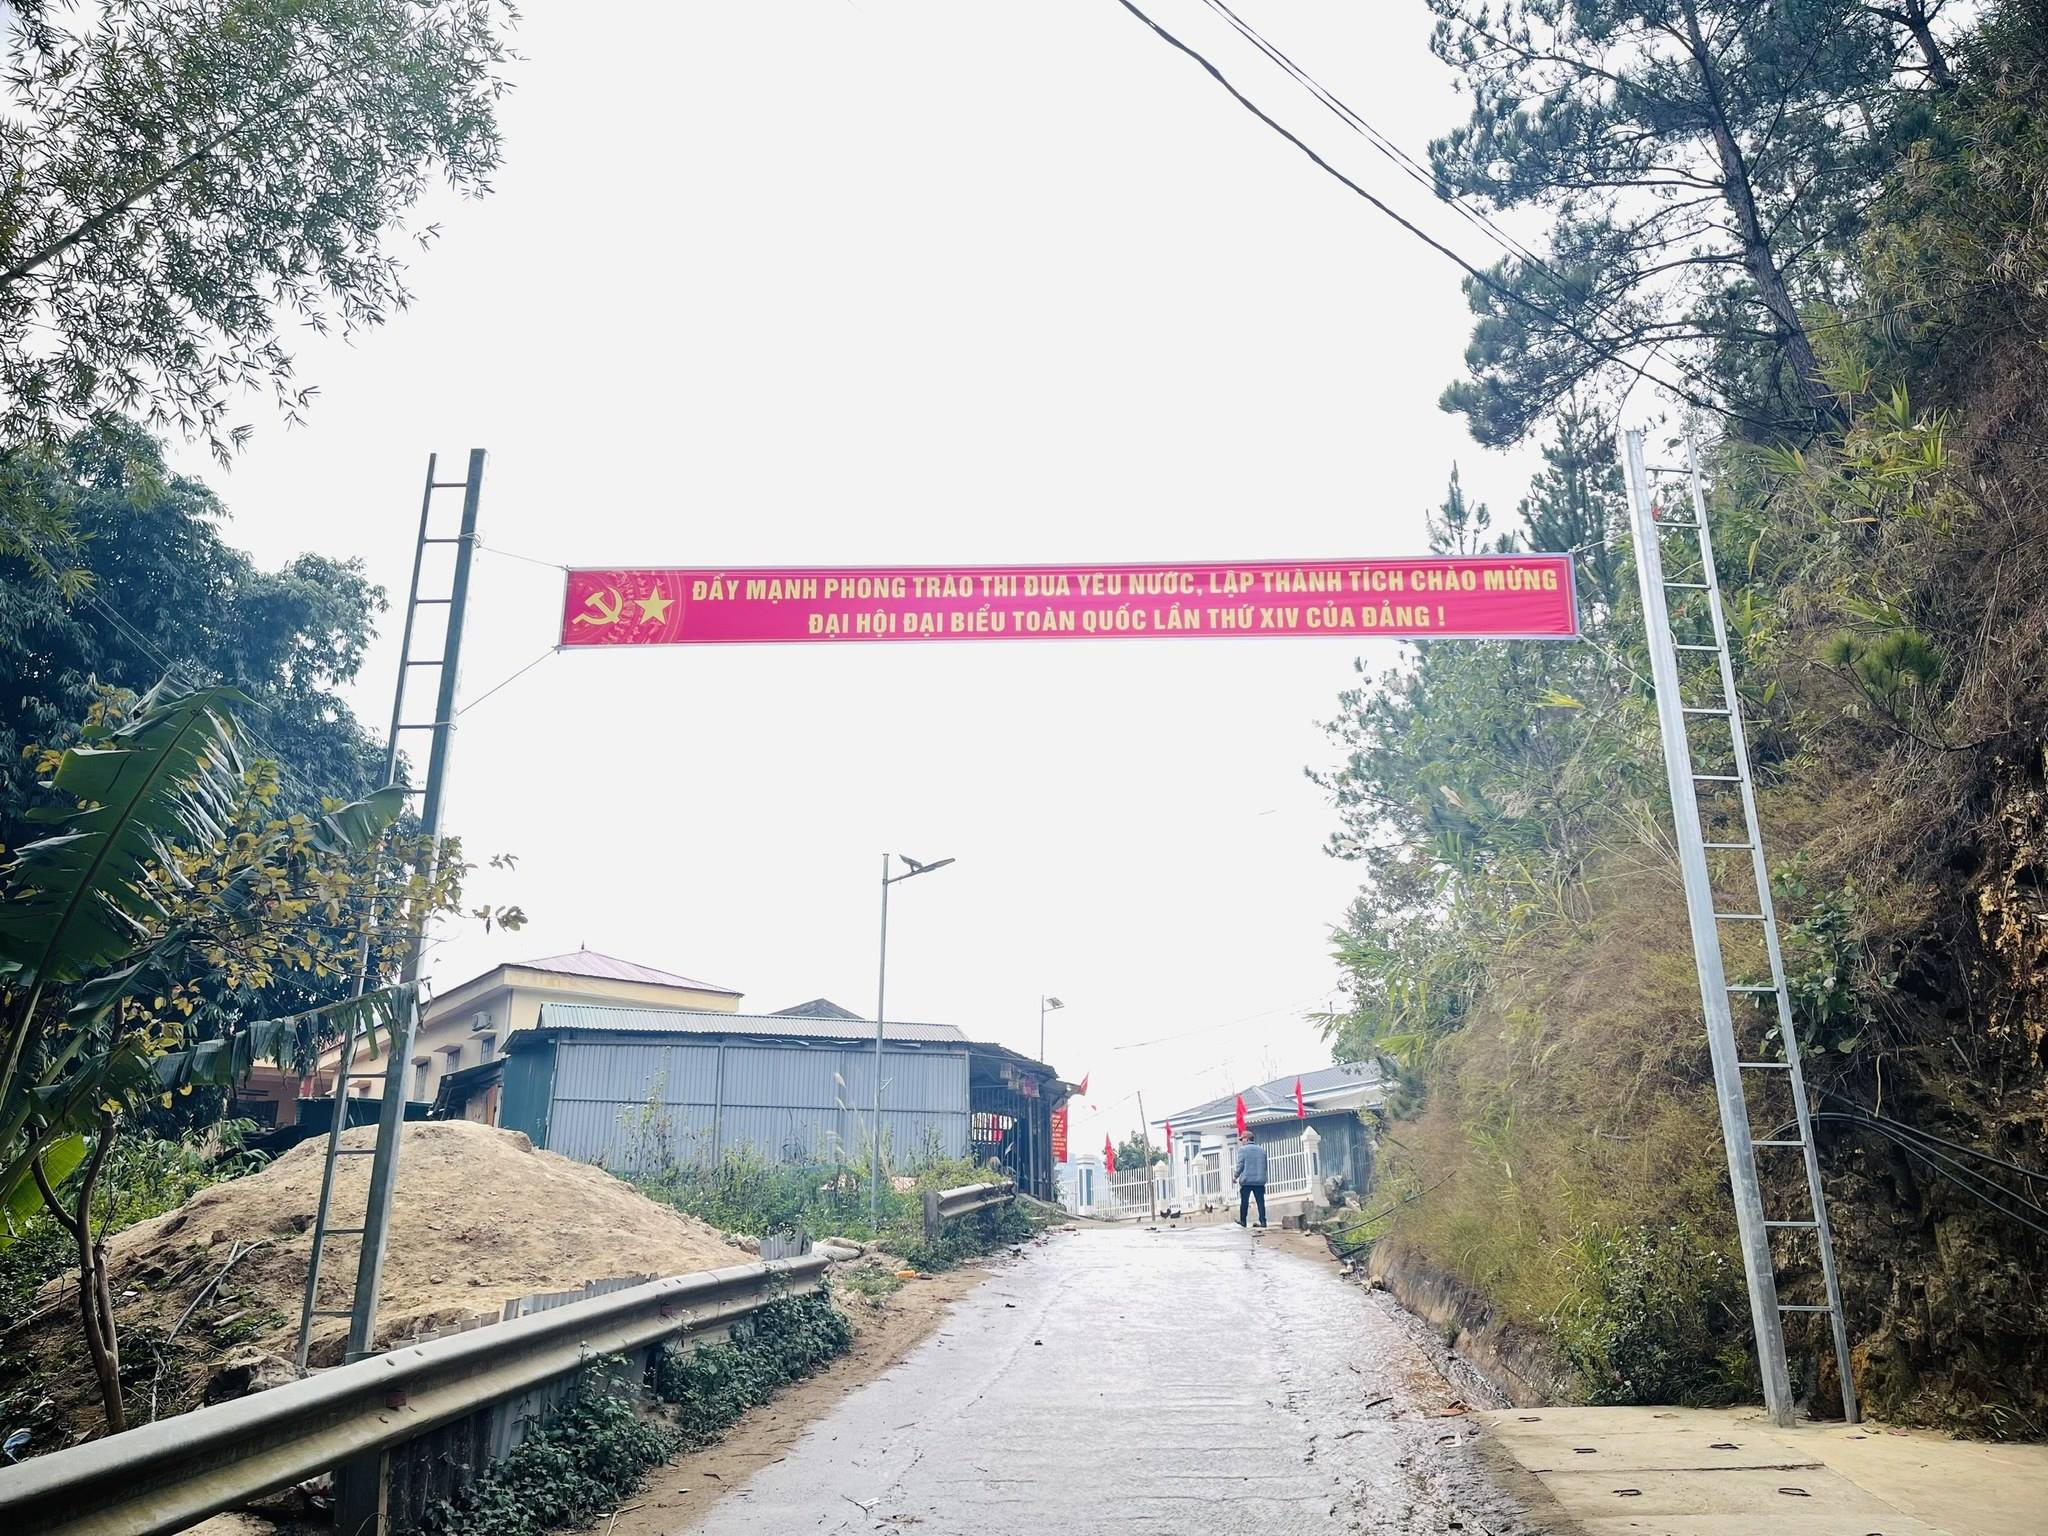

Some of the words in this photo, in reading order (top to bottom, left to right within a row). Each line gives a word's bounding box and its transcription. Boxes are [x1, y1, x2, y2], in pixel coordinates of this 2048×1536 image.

[746, 578, 817, 604] MẠNH
[824, 577, 905, 599] PHONG
[980, 575, 1017, 597] THI
[1023, 574, 1070, 596] ĐUA
[1076, 571, 1121, 596] YÊU
[1129, 571, 1203, 598] NƯỚC,
[1209, 570, 1255, 599] LẬP
[1262, 568, 1342, 593] THÀNH
[1348, 567, 1404, 592] TÍCH
[1411, 565, 1476, 592] CHÀO
[1484, 565, 1558, 591] MỪNG
[808, 612, 849, 638] ĐẠI
[856, 609, 896, 637] HỘI
[902, 612, 943, 637] ĐẠI
[951, 603, 1006, 632] BIỂU
[1012, 606, 1075, 632] TOÀN
[1082, 602, 1147, 633] QUỐC
[1154, 602, 1200, 631] LẦN
[1207, 603, 1255, 629] THỨ
[1260, 607, 1300, 628] XIV
[1306, 600, 1356, 628] CỦA
[1362, 600, 1430, 628] ĐẢNG
[1437, 605, 1446, 628] !
